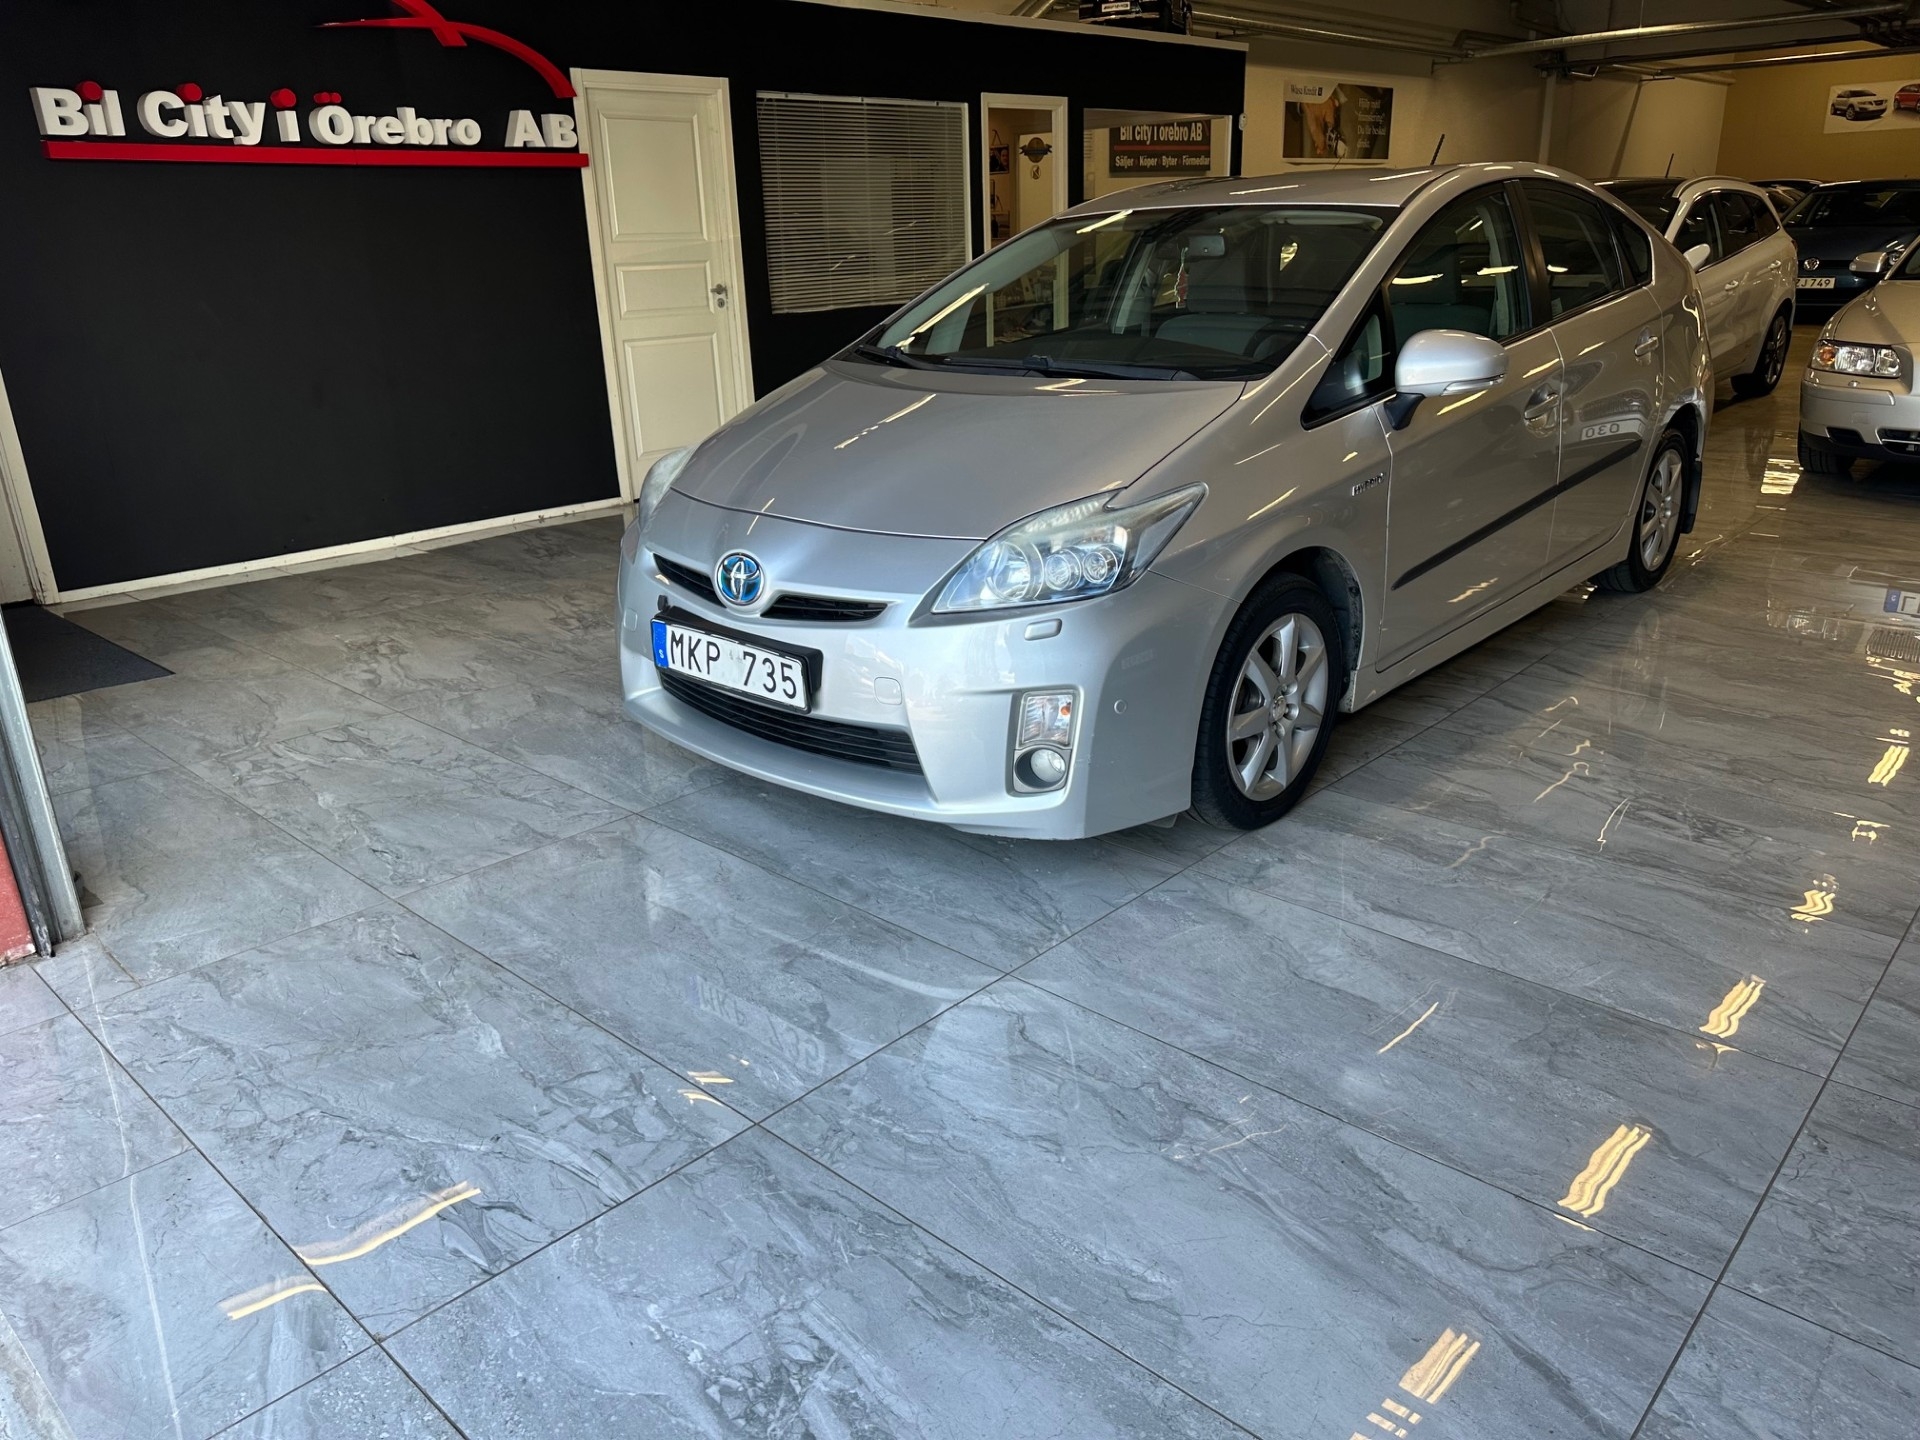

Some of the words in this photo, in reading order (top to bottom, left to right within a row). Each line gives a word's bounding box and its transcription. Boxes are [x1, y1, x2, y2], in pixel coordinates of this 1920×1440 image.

[29, 81, 126, 138] Bil
[137, 82, 266, 146] City
[270, 88, 300, 142] i
[308, 92, 482, 146] Örebro
[504, 109, 578, 148] AB
[1190, 122, 1203, 141] AB
[1810, 278, 1831, 288] 749
[670, 630, 721, 675] MKP
[743, 650, 797, 700] 735
